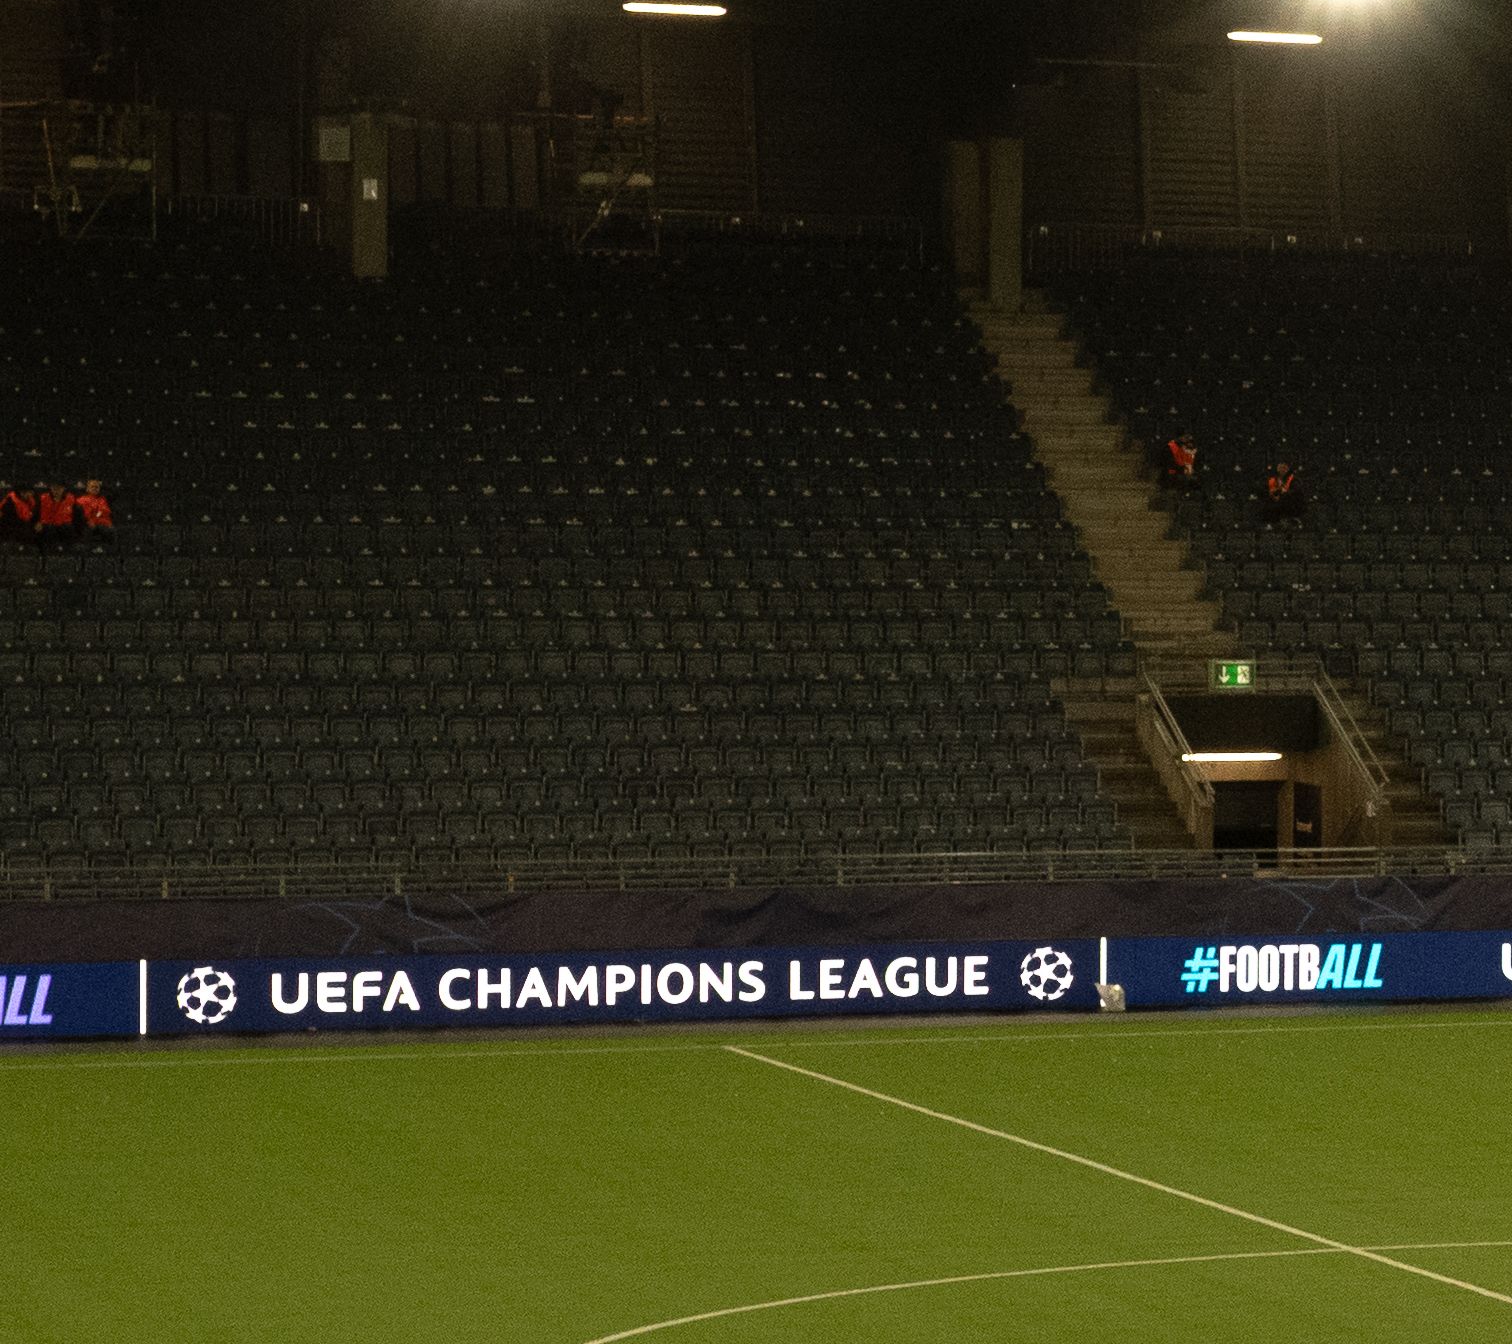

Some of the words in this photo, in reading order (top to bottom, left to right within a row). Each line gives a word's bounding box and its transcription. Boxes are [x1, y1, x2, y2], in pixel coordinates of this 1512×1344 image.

[272, 971, 422, 1016] UEFA
[439, 961, 767, 1012] CHAMPIONS
[790, 956, 991, 1002] LEAGUE
[1181, 944, 1384, 994] #FOOTBALL
